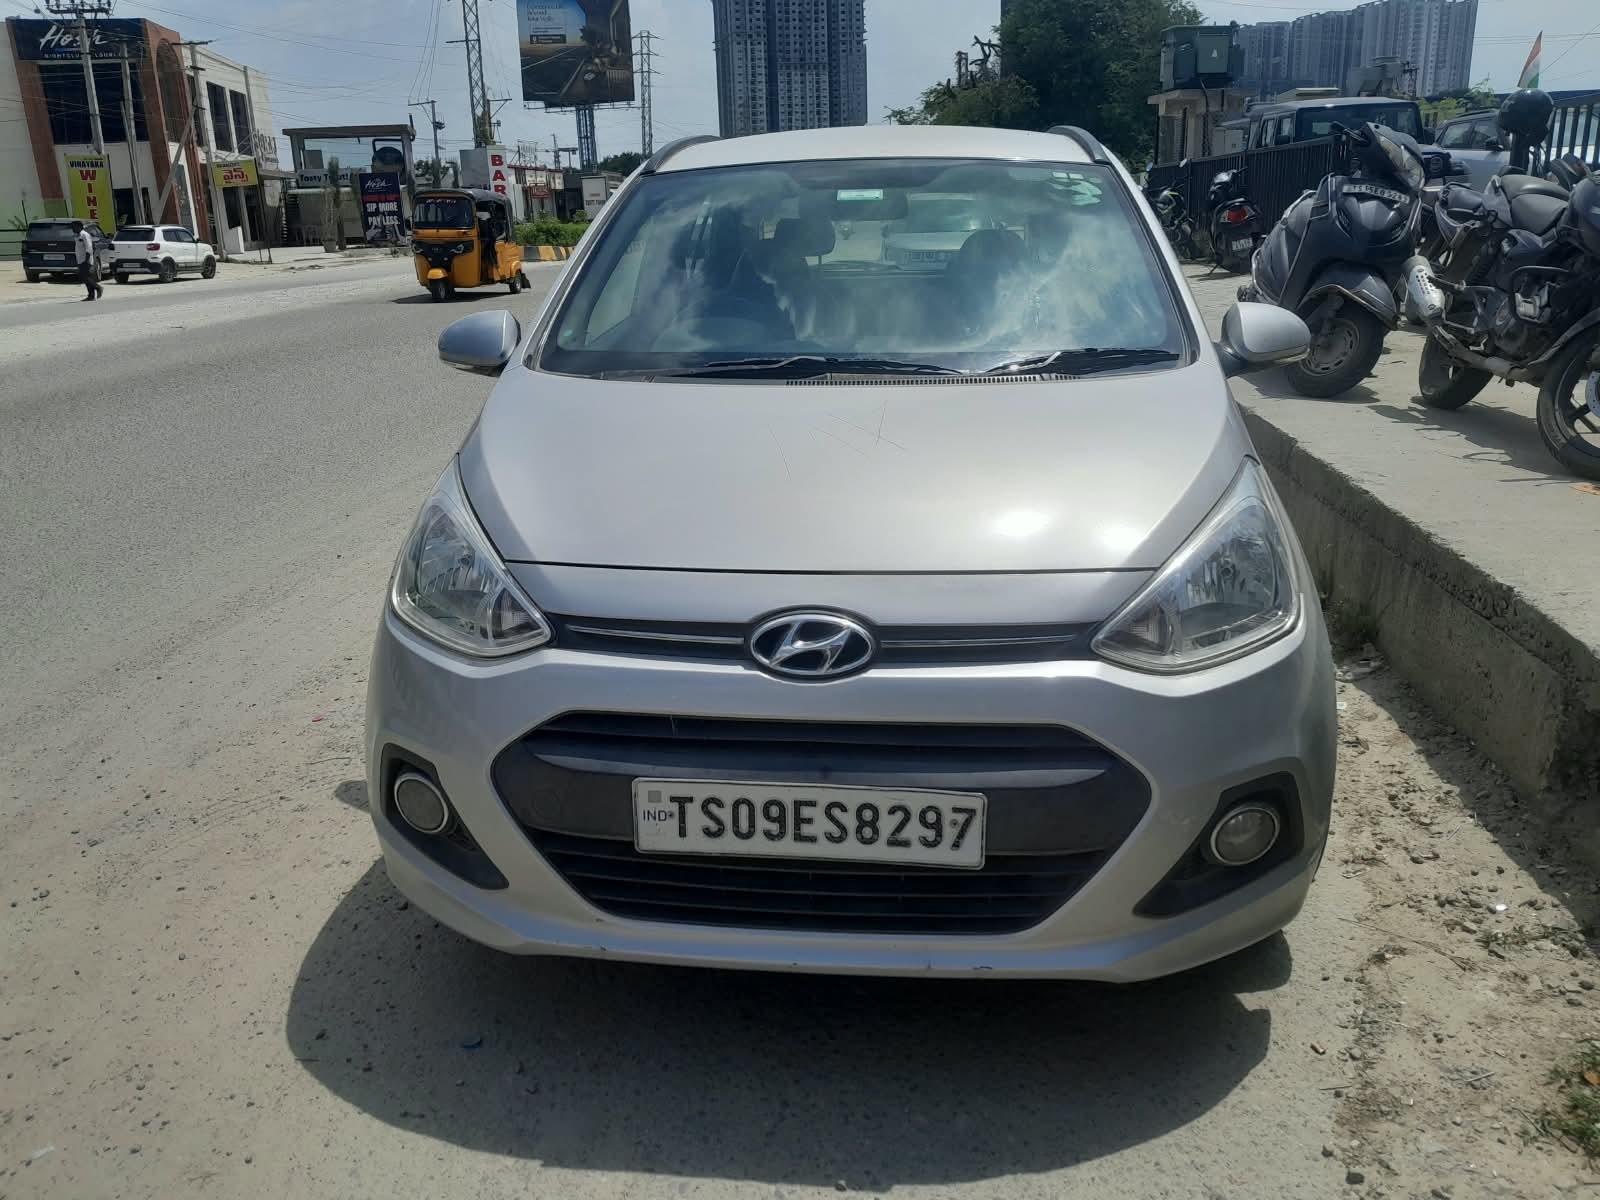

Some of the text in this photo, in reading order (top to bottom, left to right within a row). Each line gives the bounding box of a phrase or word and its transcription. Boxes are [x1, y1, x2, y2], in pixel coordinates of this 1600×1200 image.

[490, 154, 507, 194] BAR
[366, 202, 398, 212] SIP MORE
[368, 217, 381, 226] PAY
[643, 796, 977, 850] IND TS09ES8297
